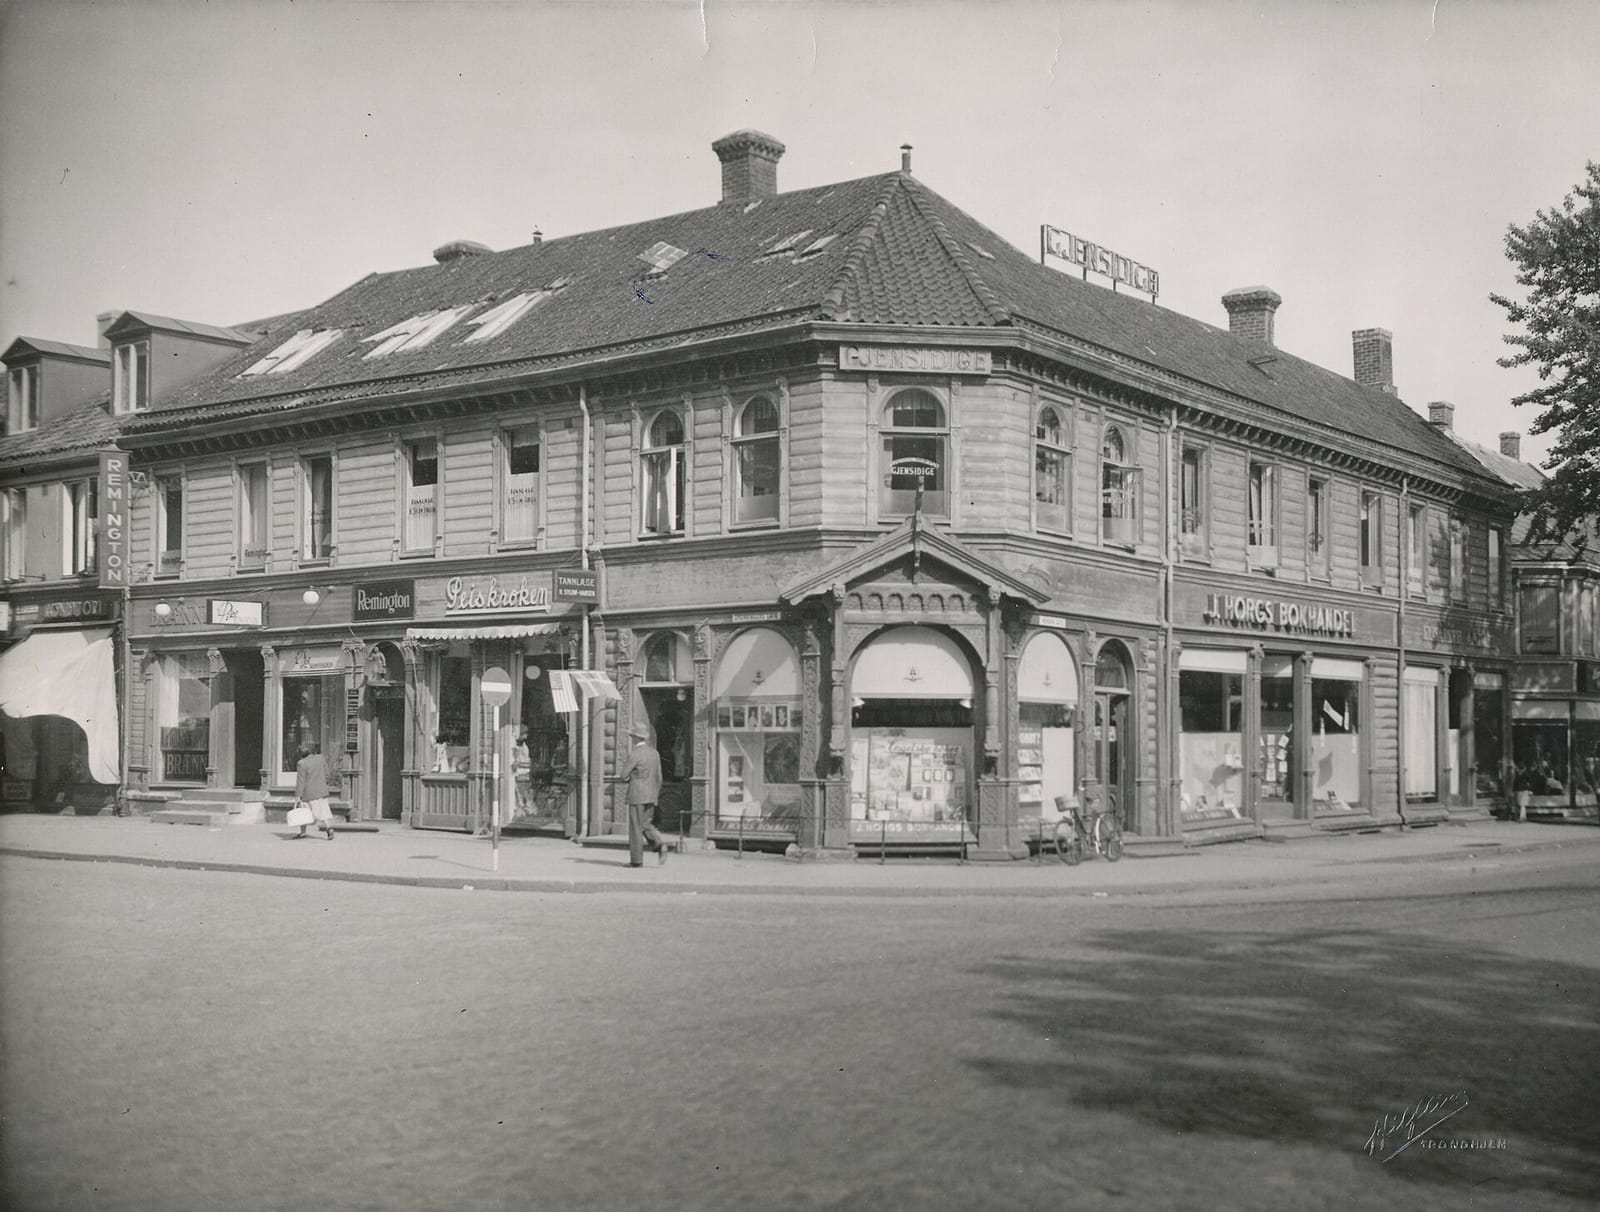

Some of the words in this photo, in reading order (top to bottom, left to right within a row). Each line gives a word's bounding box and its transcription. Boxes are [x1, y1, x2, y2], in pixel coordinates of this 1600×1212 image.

[1046, 226, 1159, 298] GJENSIDIGE
[846, 346, 987, 371] GJENSIDIGE
[890, 466, 935, 476] GJENSIDIGE
[106, 458, 122, 582] REMINGTON
[357, 589, 410, 614] Remington
[445, 576, 550, 613] Peiskroken
[1224, 594, 1274, 624] HORGS
[1279, 602, 1357, 633] BOKHANDEL
